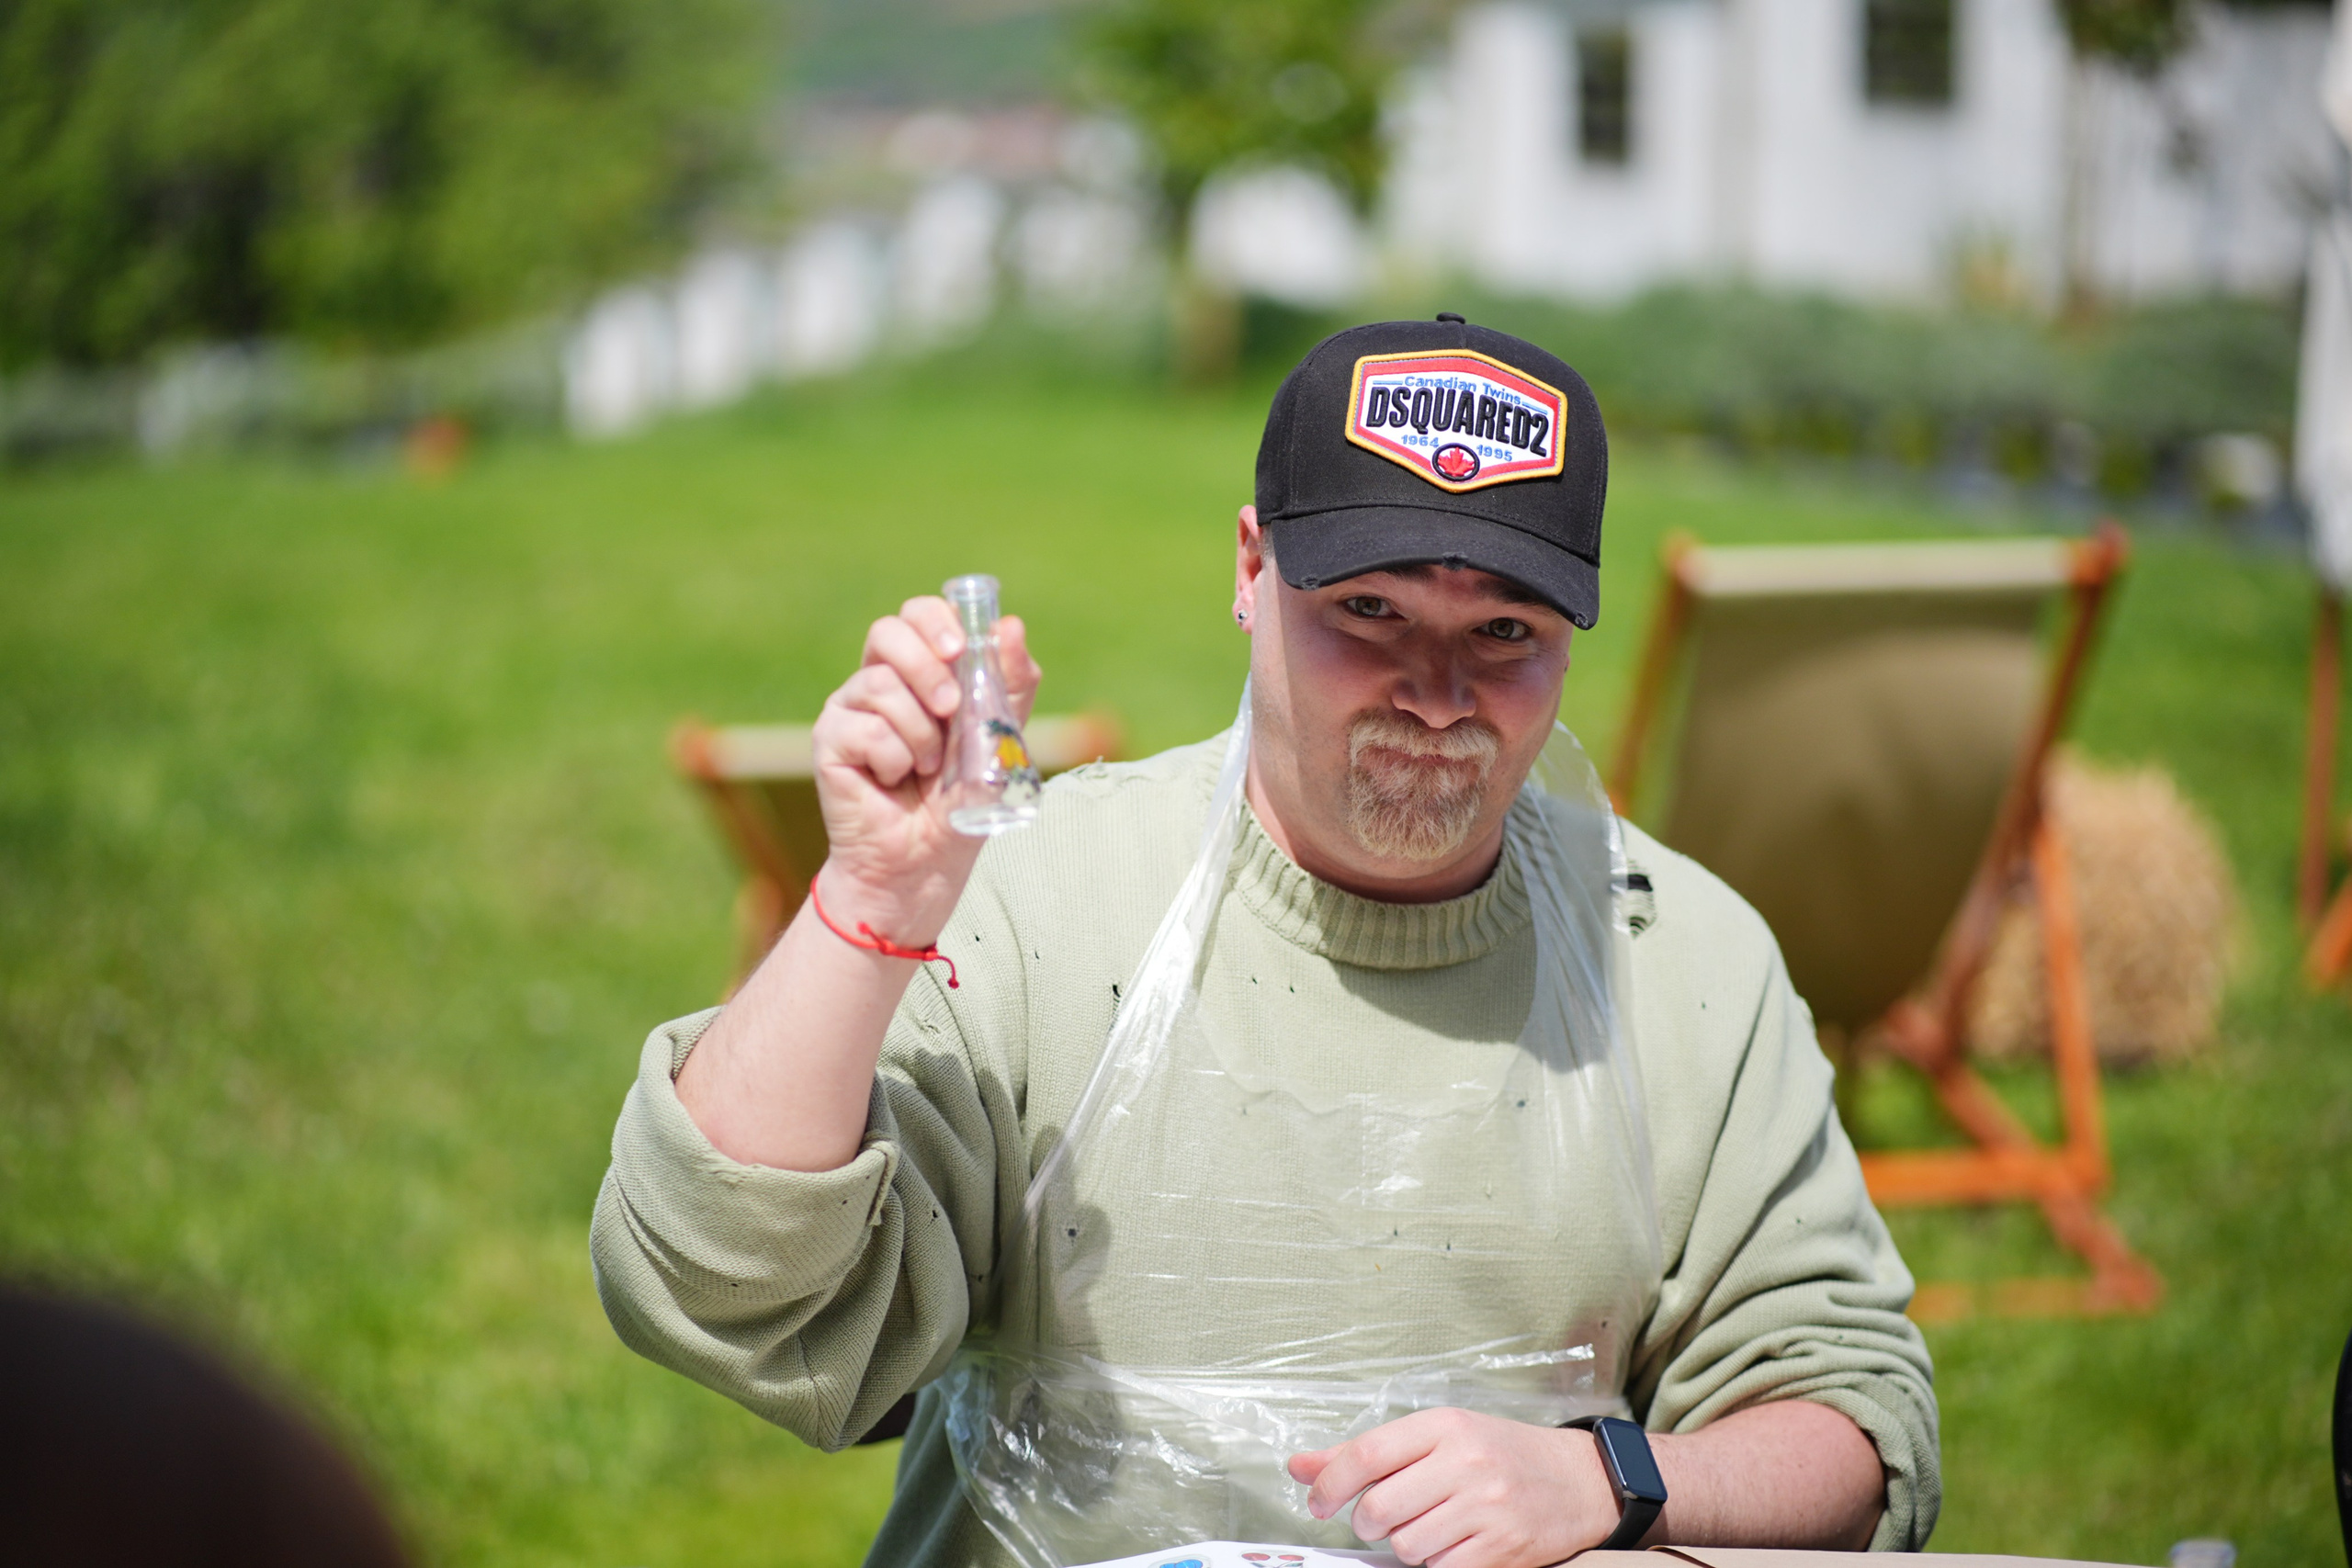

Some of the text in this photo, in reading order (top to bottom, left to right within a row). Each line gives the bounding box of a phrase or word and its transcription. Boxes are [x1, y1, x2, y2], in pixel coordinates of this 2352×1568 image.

[1405, 376, 1521, 405] Canadian Twins
[1366, 386, 1549, 457] DSQUARED2
[1401, 434, 1513, 462] 1964 1995
